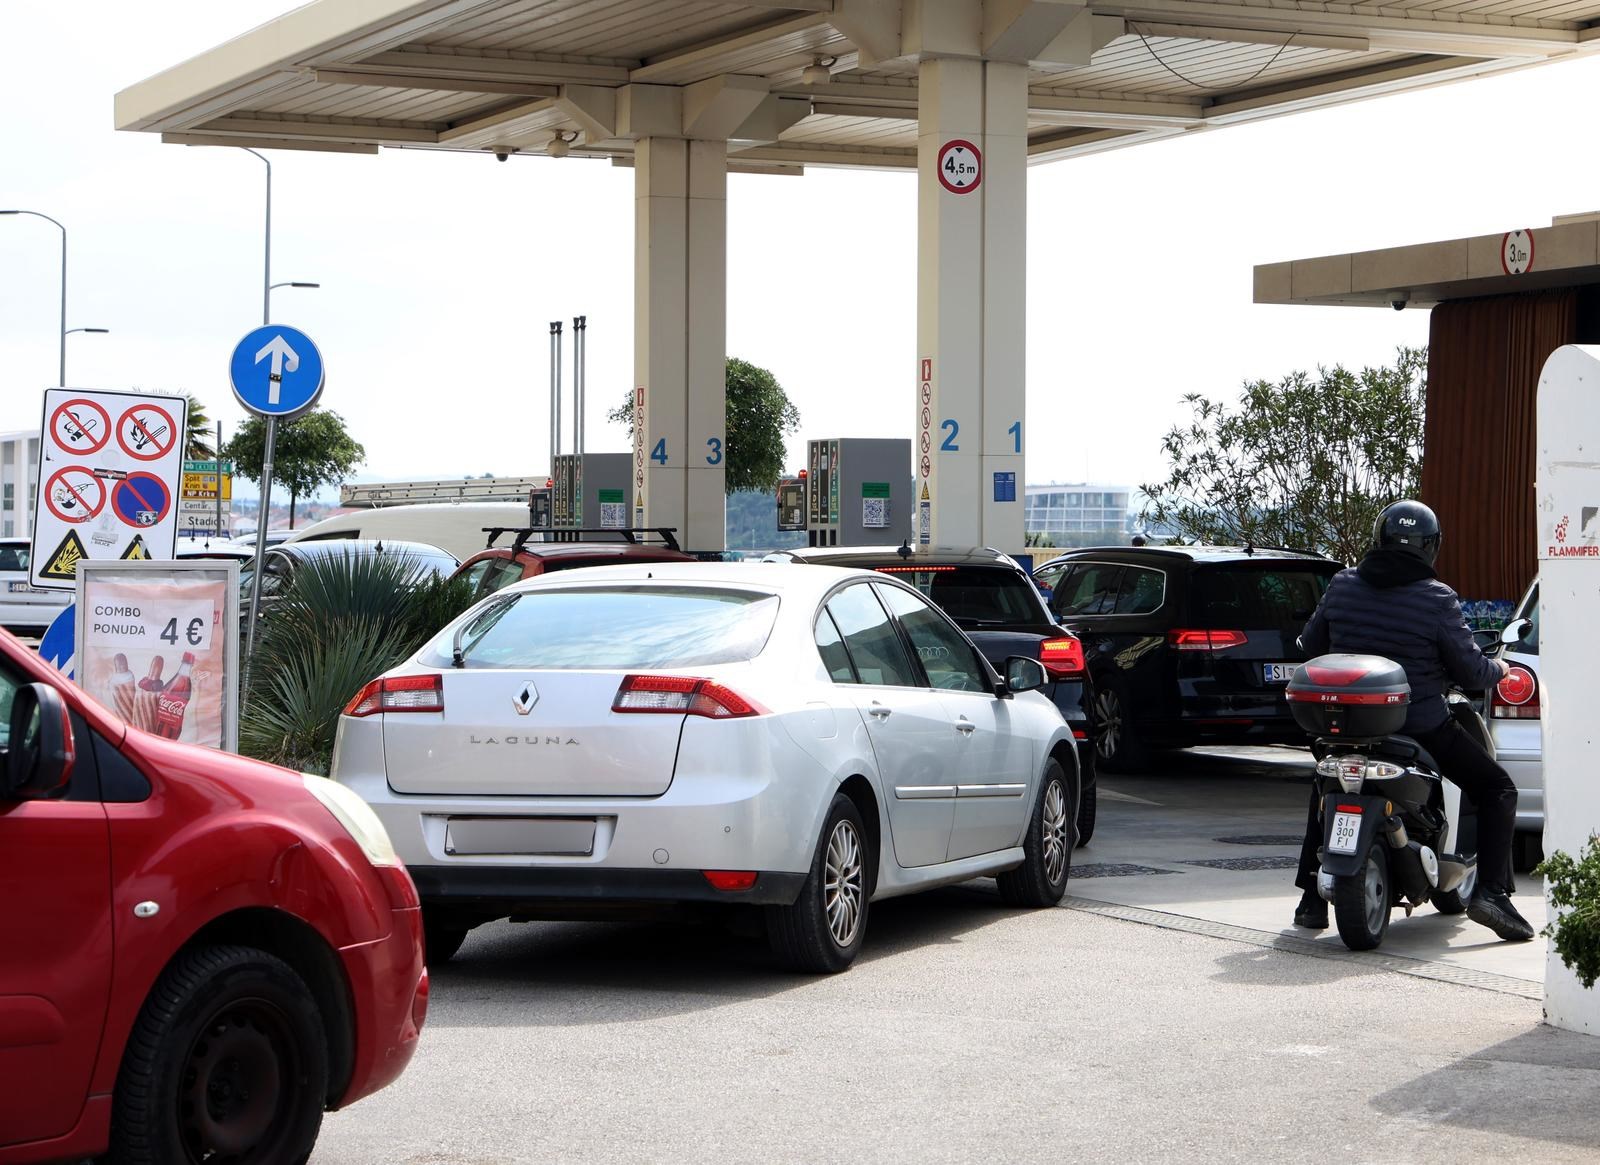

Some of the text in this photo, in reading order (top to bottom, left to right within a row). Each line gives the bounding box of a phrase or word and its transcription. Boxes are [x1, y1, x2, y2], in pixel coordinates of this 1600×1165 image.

[941, 419, 959, 451] 2
[1008, 421, 1021, 453] 1
[651, 438, 668, 465] 4
[706, 438, 722, 465] 3
[1548, 546, 1599, 557] FLAMMIFER
[95, 605, 141, 617] COMBO
[94, 623, 146, 635] PONUDA
[160, 617, 178, 645] 4
[185, 617, 204, 646] €
[1273, 665, 1285, 679] SI
[470, 735, 580, 745] LAGUNA
[1337, 816, 1350, 827] SI
[1336, 828, 1354, 837] 300
